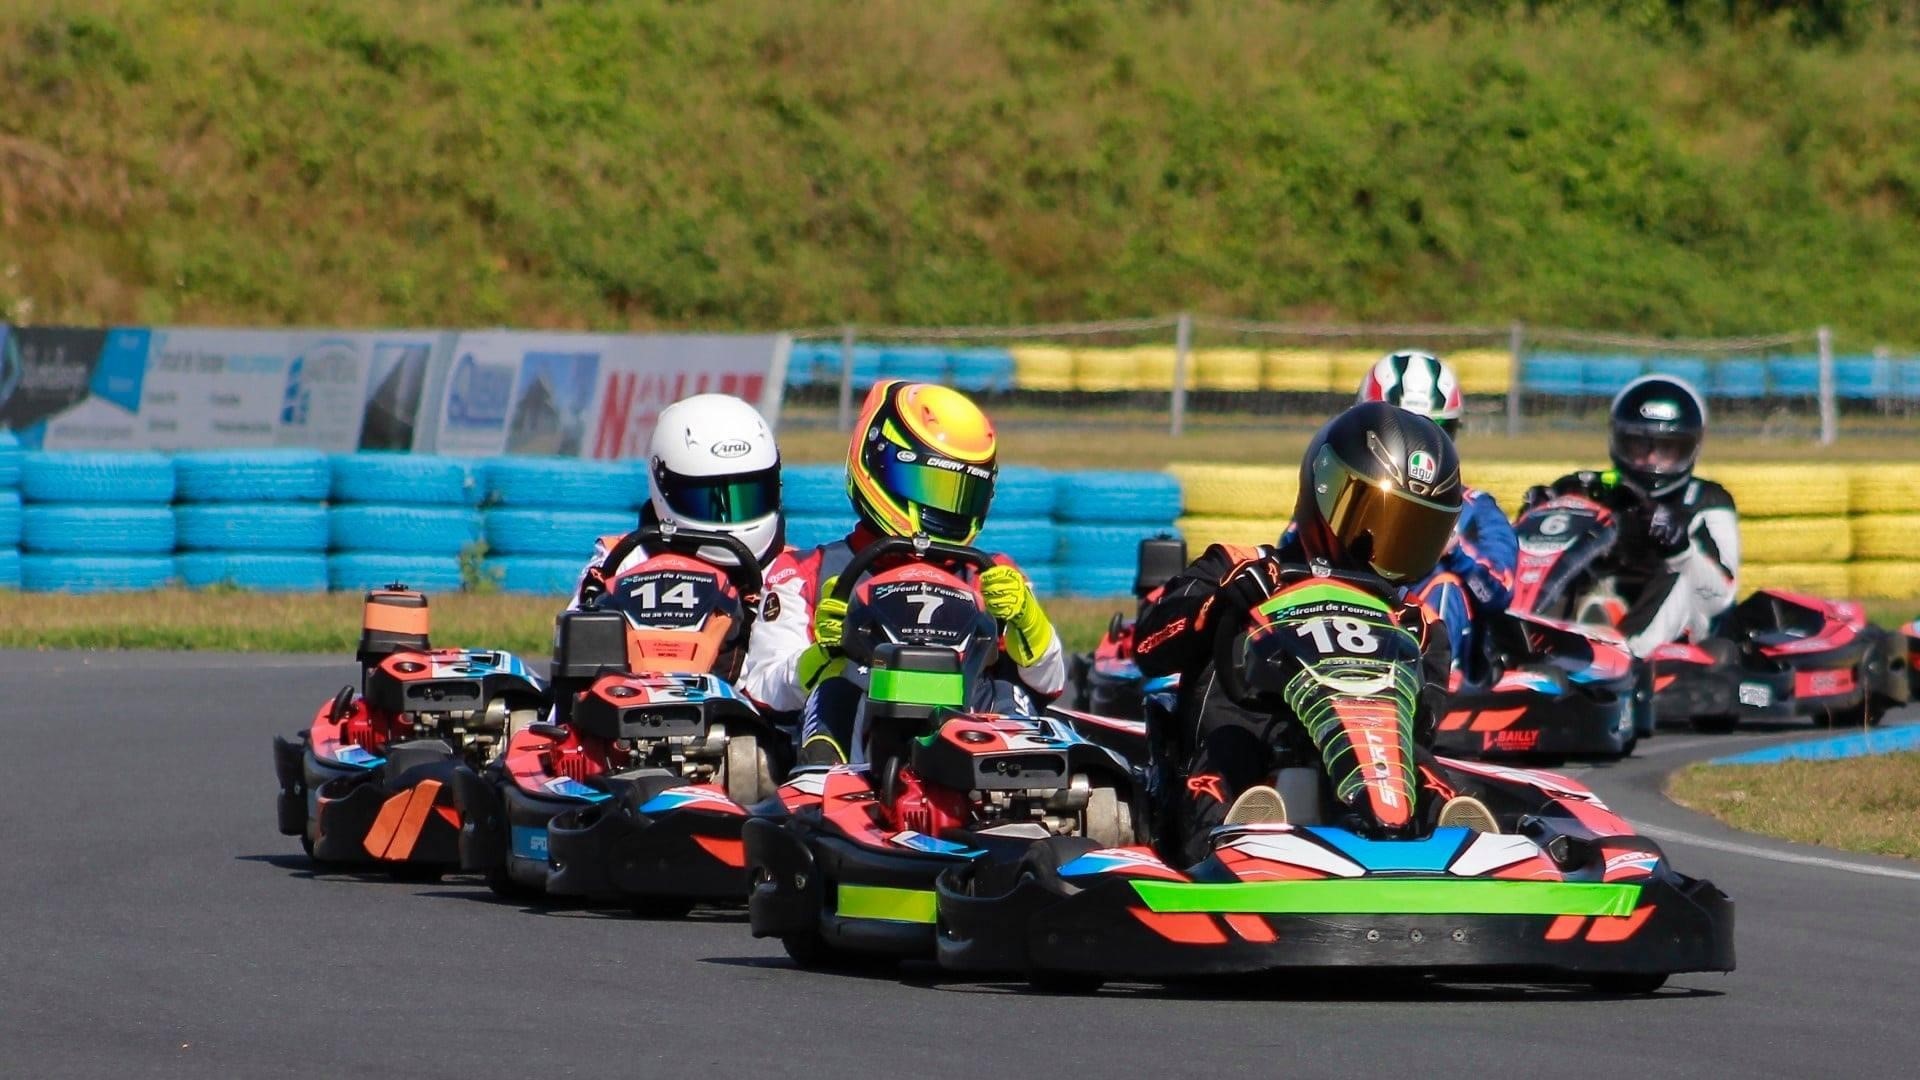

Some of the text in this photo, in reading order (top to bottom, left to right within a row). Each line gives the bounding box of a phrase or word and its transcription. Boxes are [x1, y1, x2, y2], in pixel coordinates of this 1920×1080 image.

[926, 457, 965, 471] CHERY
[1540, 514, 1569, 535] 6
[630, 582, 699, 609] 14
[906, 594, 944, 624] 7
[1325, 603, 1339, 611] de
[1341, 605, 1383, 618] l'europe
[1296, 617, 1378, 654] 18
